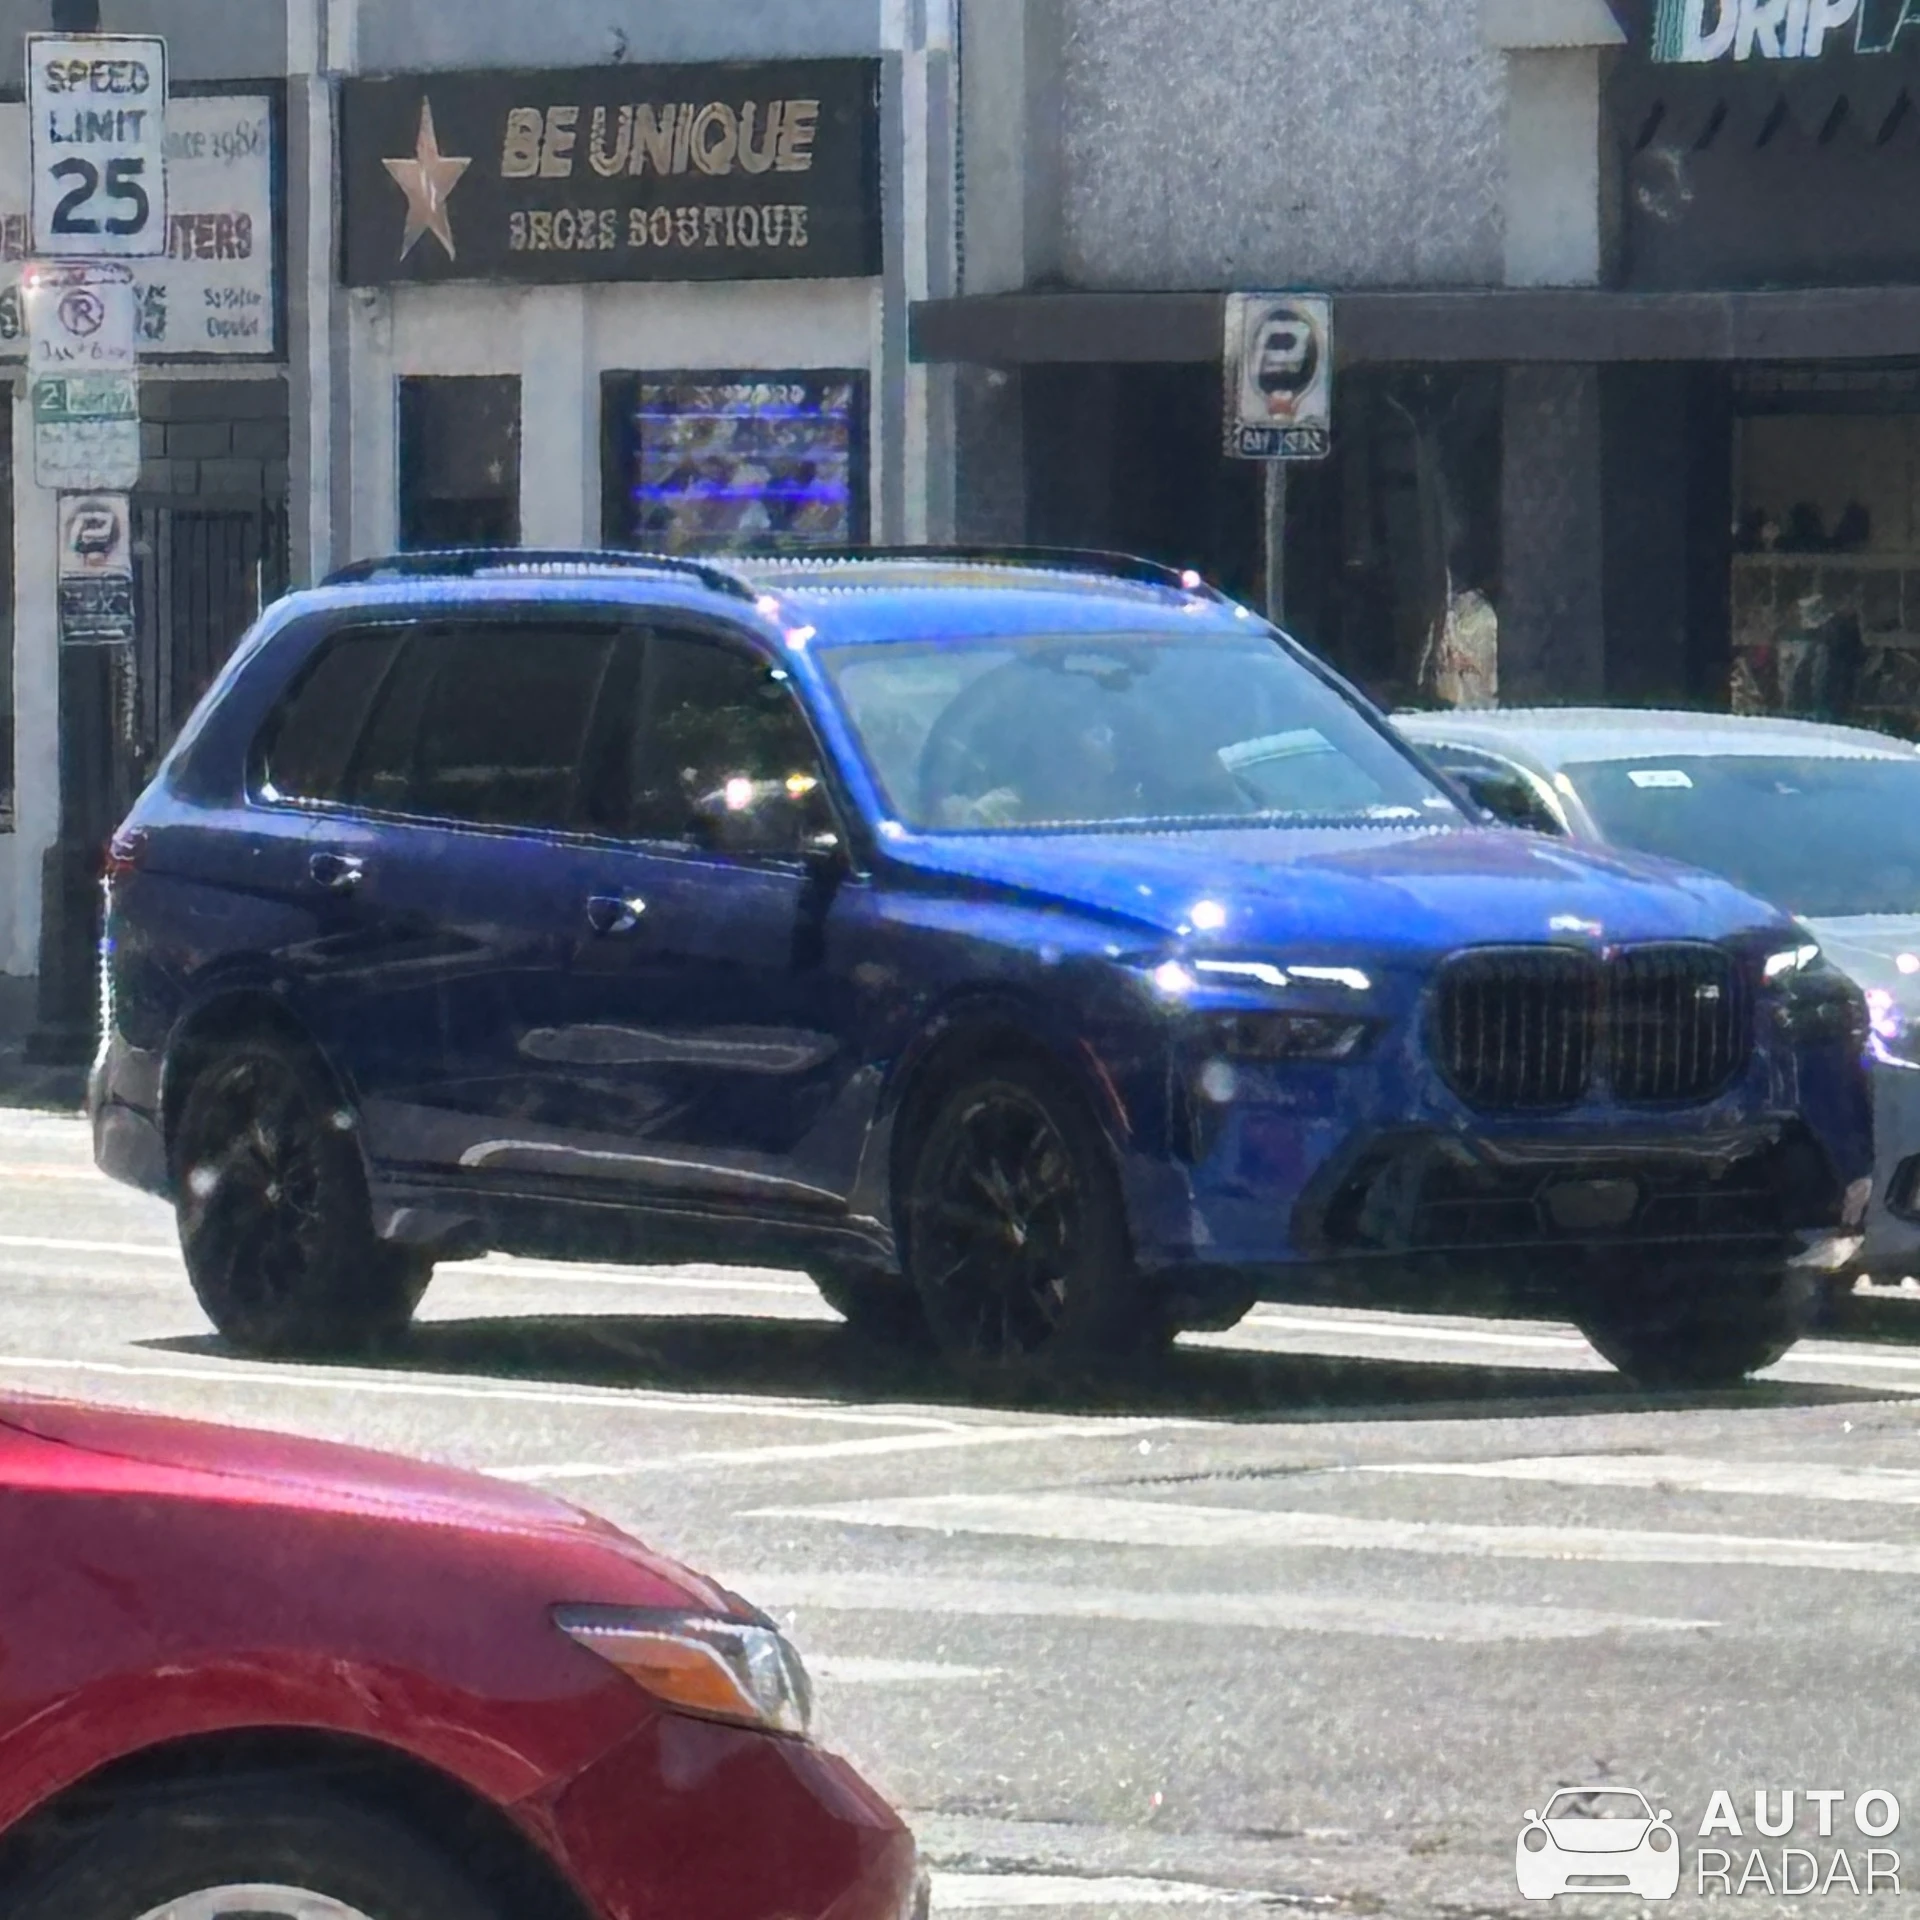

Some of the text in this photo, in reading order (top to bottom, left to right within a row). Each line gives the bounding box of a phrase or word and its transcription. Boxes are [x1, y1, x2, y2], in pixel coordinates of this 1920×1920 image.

[45, 59, 150, 94] SPEED
[49, 109, 148, 143] LIMIT
[501, 99, 820, 178] BE UNIQUE
[48, 156, 150, 235] 25
[627, 204, 809, 248] BOUTIQUE
